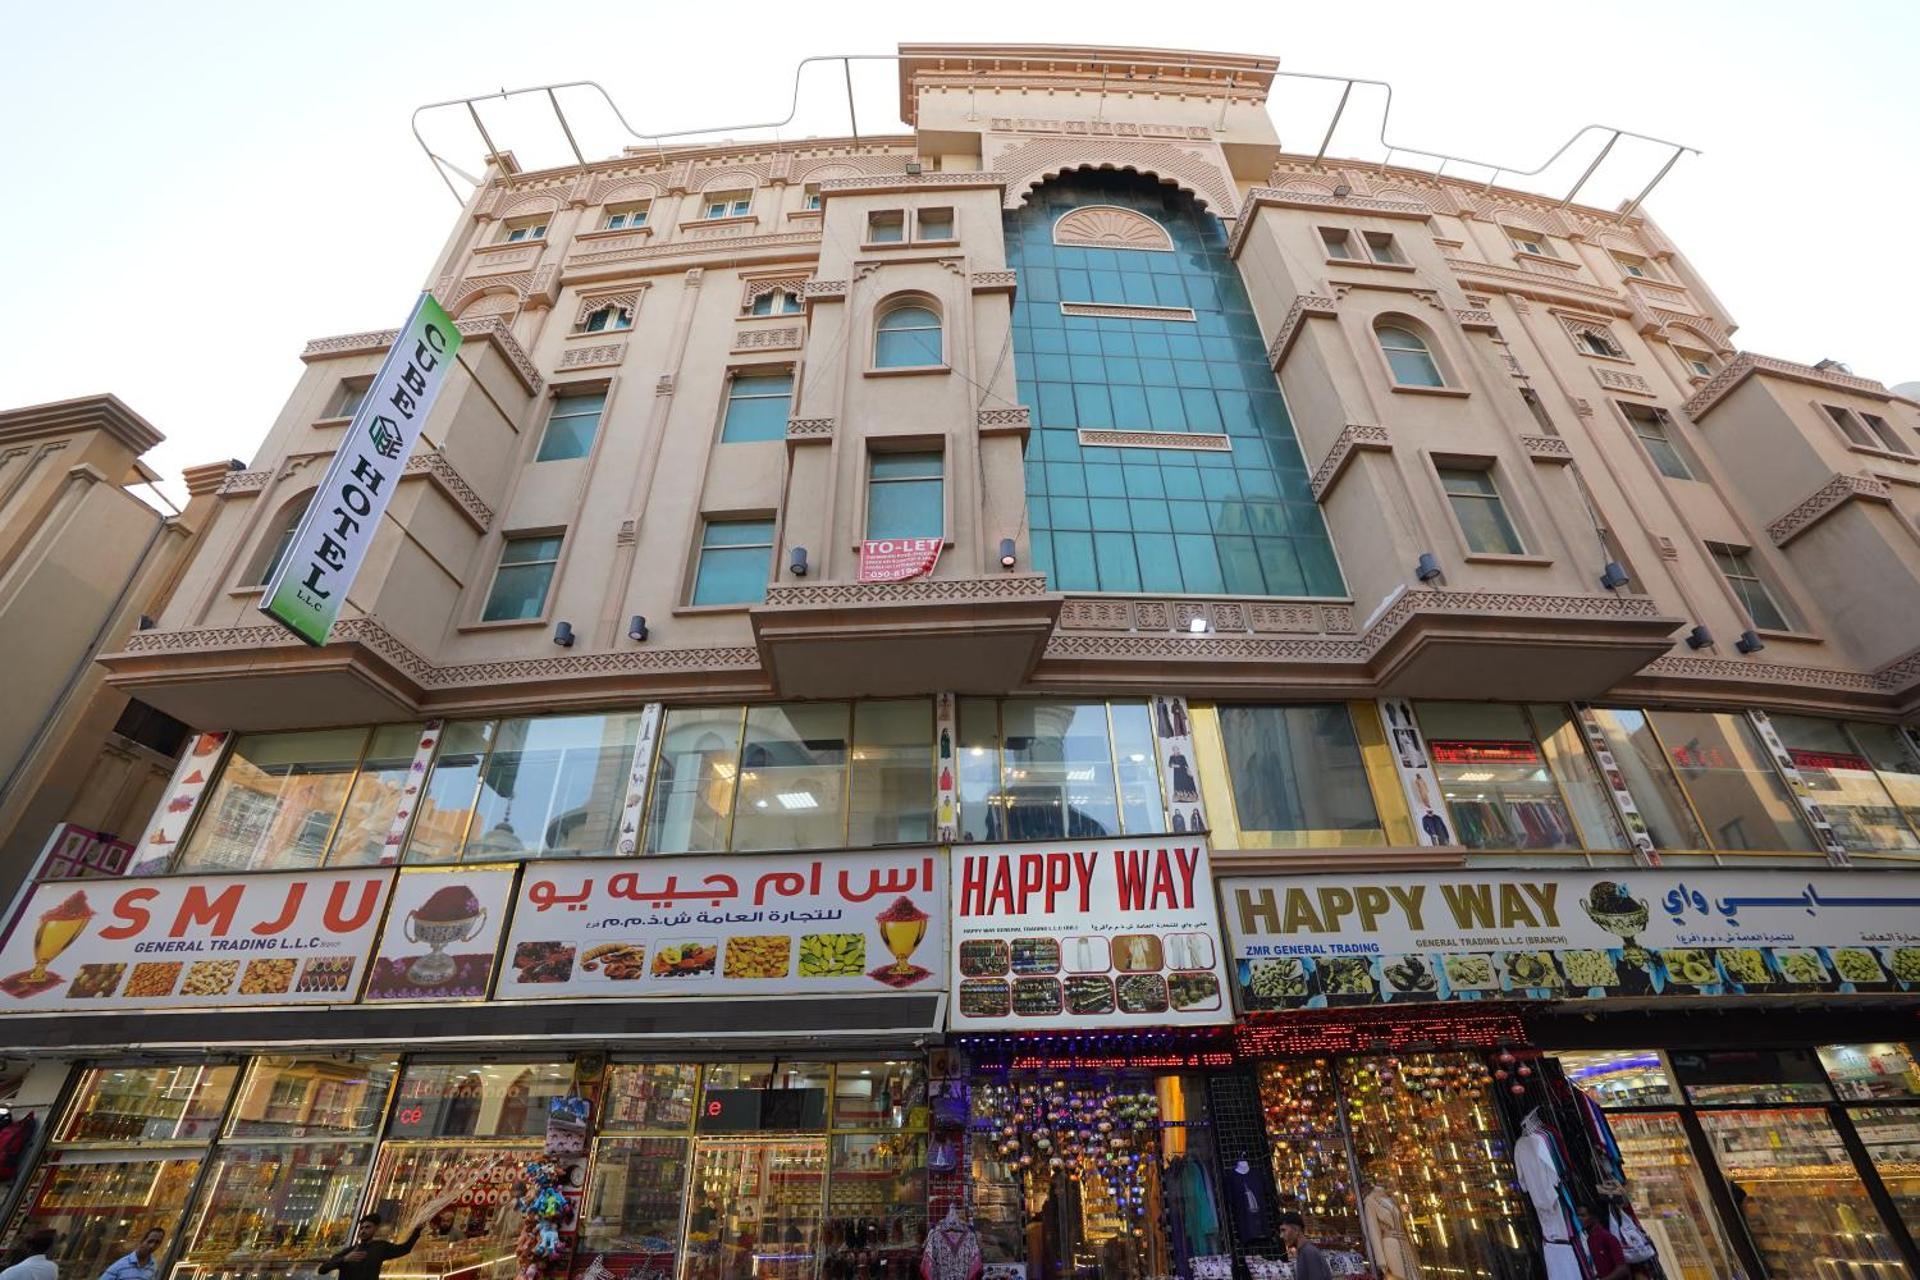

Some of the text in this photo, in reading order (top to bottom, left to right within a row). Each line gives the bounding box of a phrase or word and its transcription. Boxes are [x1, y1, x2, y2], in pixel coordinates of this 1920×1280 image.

[390, 322, 447, 420] CUBE
[302, 453, 386, 601] HOTEL
[865, 540, 939, 555] TO-LET
[296, 588, 323, 613] L.L.C
[528, 858, 934, 912] اس ام جيه يو
[959, 847, 1200, 917] HAPPY WAY
[767, 908, 842, 924] للتجارة
[1234, 882, 1561, 936] HAPPY WAY
[1661, 881, 1710, 927] واي
[696, 911, 763, 924] العامة
[133, 940, 204, 953] GENERAL
[210, 938, 276, 951] TRADING
[280, 936, 321, 950] L.L.C
[1246, 942, 1380, 956] ZMR GENERAL TRADING
[1415, 937, 1458, 948] GENERAL
[1459, 936, 1500, 946] TRADING
[1524, 935, 1569, 946] (BRANCH)
